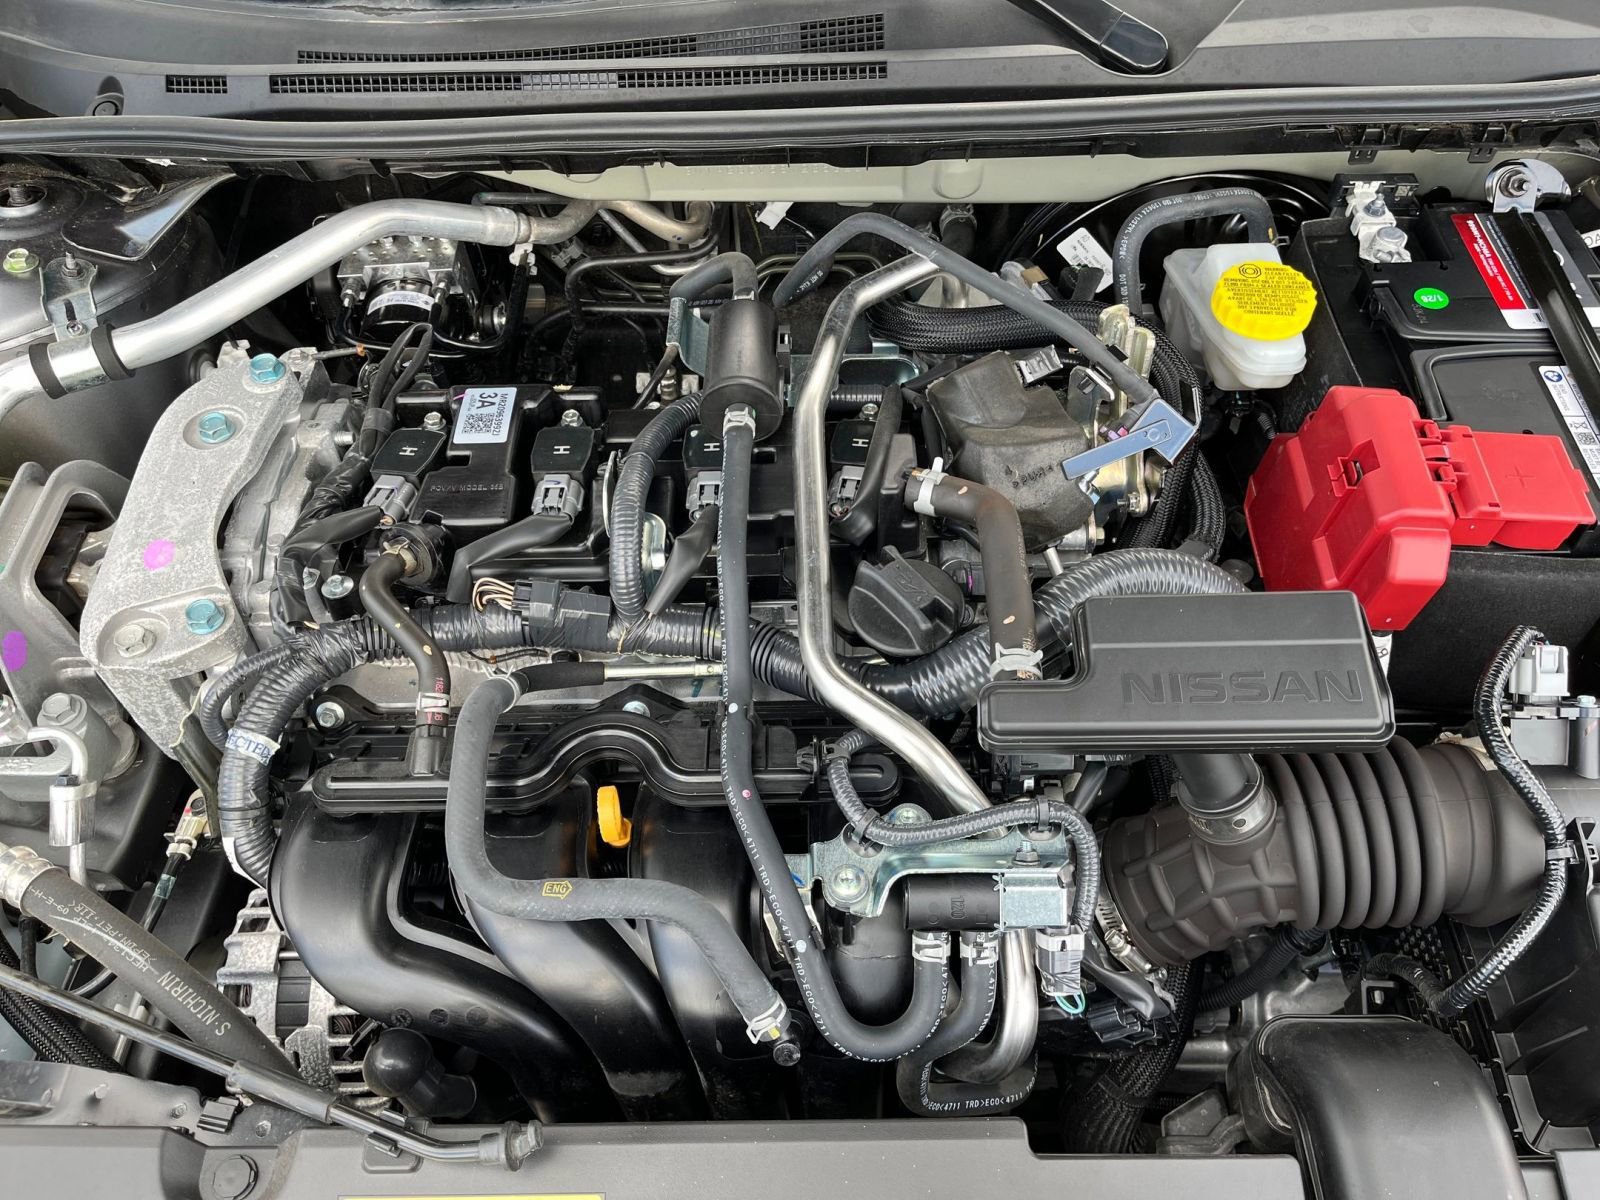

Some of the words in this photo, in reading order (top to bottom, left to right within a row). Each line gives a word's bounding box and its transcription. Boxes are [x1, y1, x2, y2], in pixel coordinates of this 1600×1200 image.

[476, 392, 498, 409] 3A
[1120, 669, 1364, 705] NISSAN
[726, 785, 760, 860] TRD>ECO<4711
[545, 883, 567, 894] ENG
[757, 864, 796, 949] TRD>ECO<4711
[794, 956, 830, 1037] TRD>ECO<4711
[965, 1092, 1024, 1110] TRD>ECO<4711
